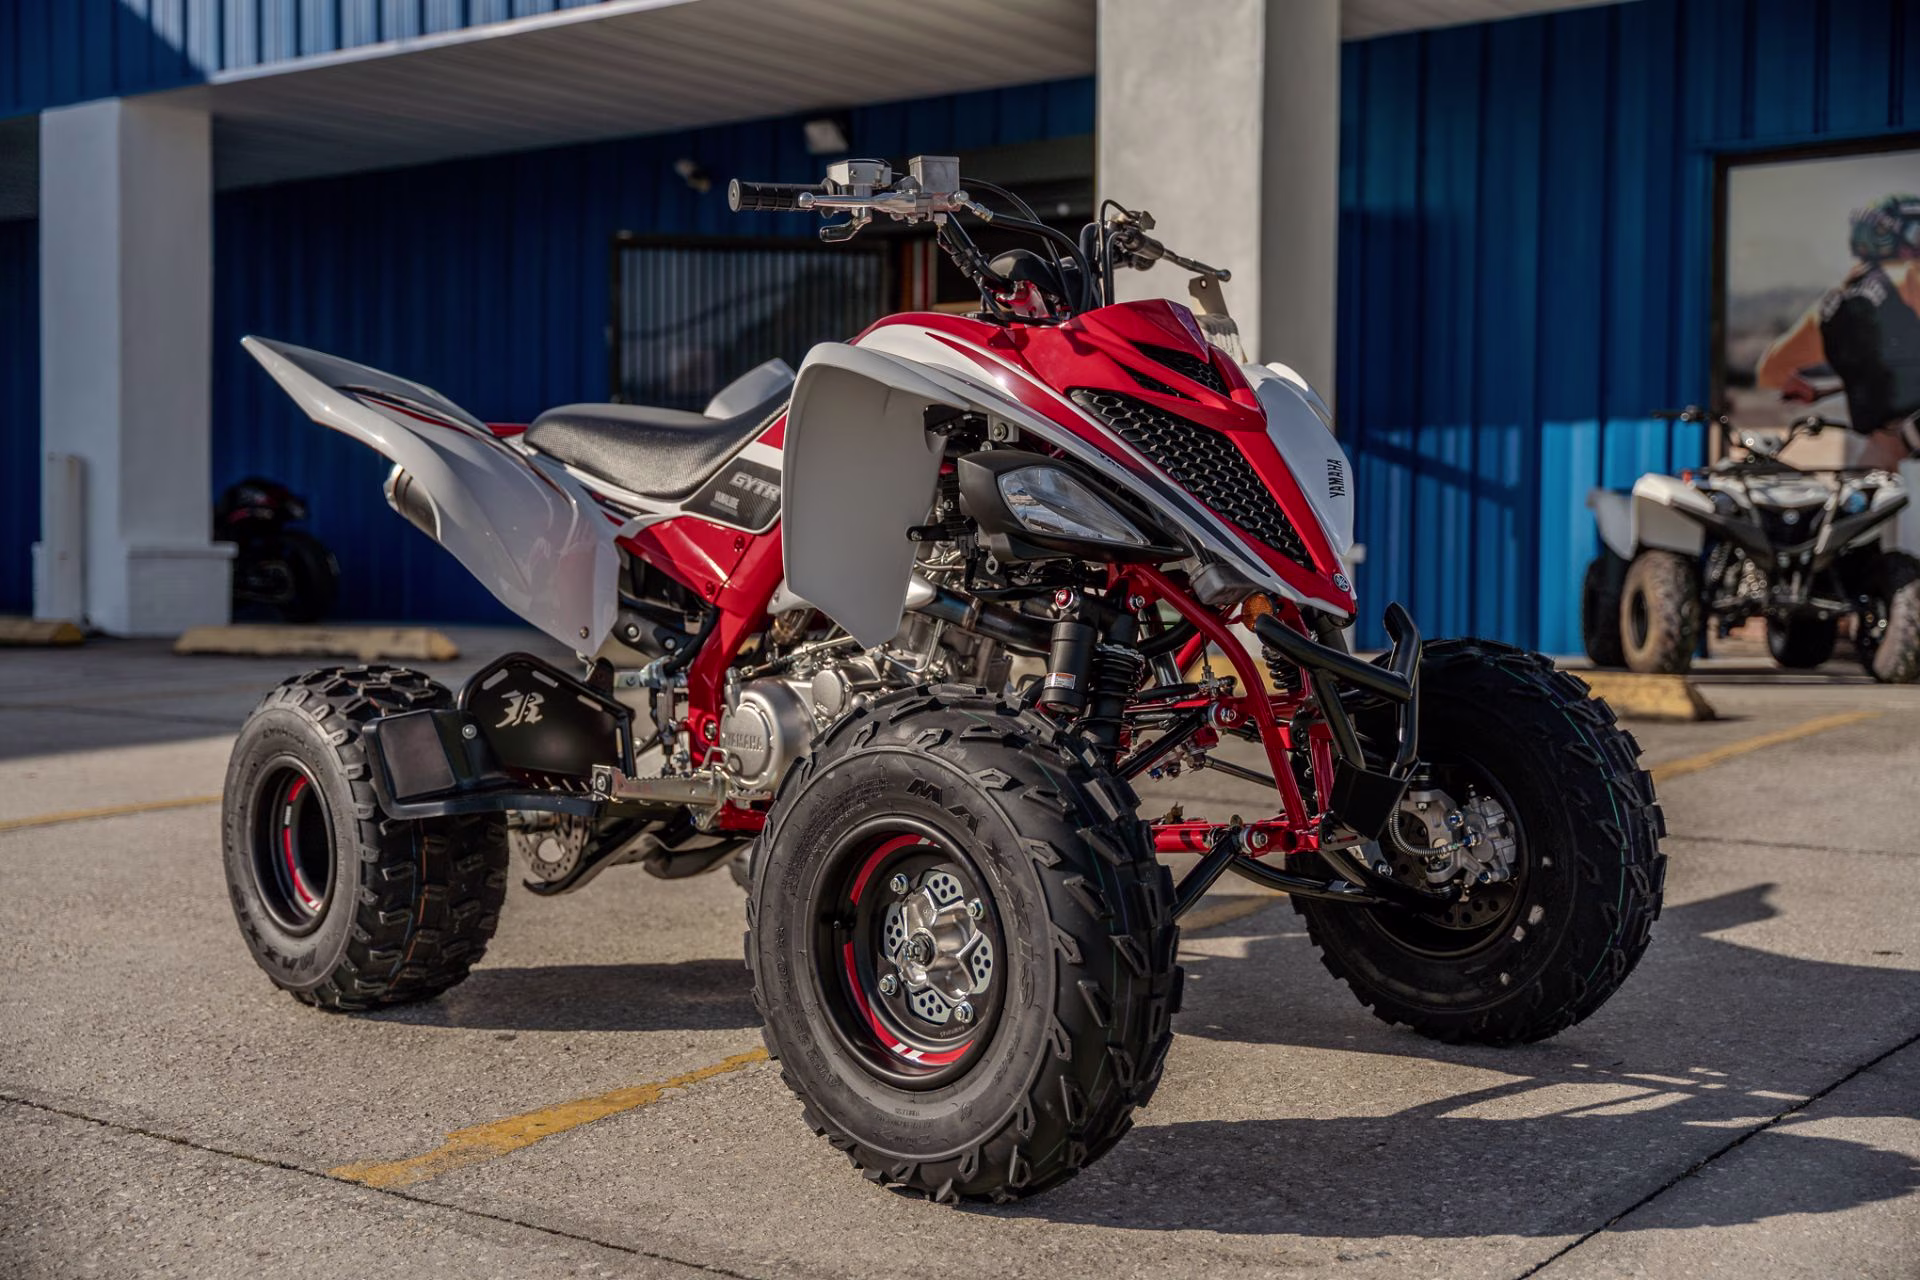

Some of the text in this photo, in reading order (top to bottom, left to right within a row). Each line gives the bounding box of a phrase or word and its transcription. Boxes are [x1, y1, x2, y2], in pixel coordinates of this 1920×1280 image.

[729, 471, 782, 502] GYTR
[1327, 458, 1346, 499] YAMAHA
[906, 777, 1035, 1010] MAXXIS
